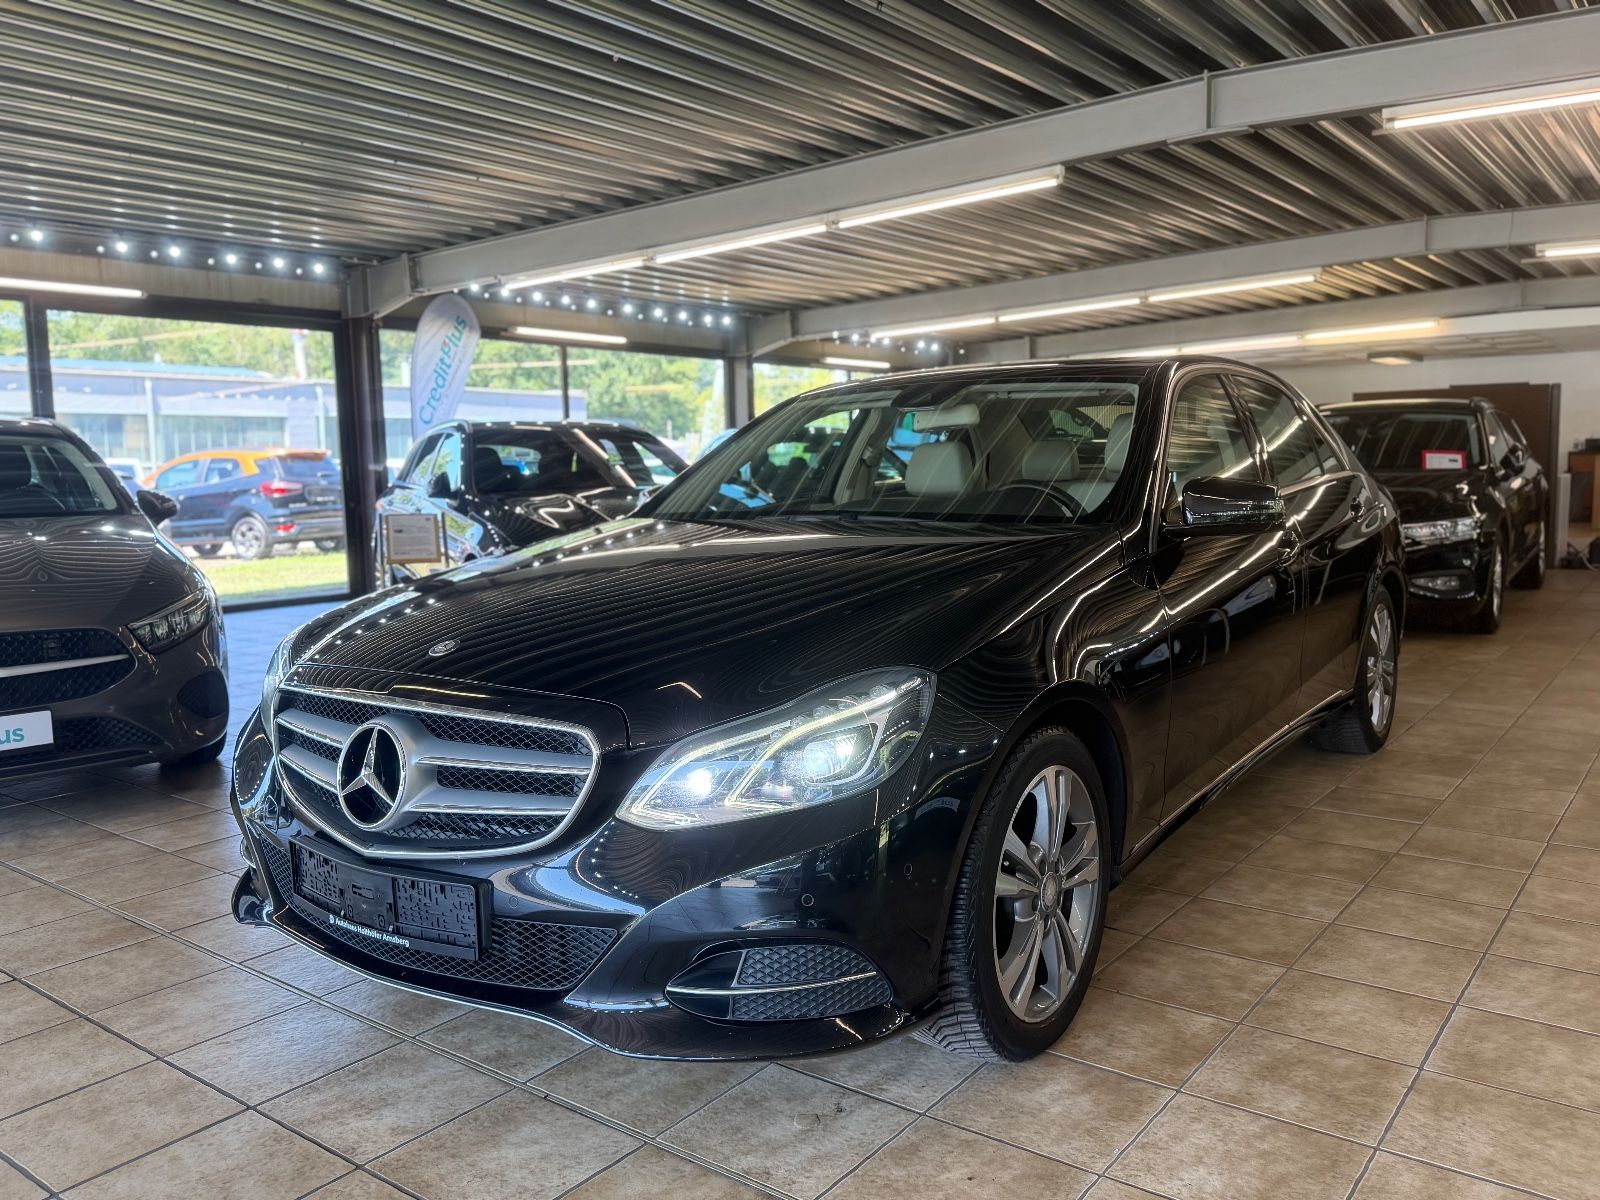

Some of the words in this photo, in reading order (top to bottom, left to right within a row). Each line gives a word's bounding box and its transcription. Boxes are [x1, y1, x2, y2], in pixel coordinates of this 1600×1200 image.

[419, 315, 467, 425] CreditPlus
[335, 917, 358, 932] Autohaus
[382, 933, 410, 948] Arnsberg
